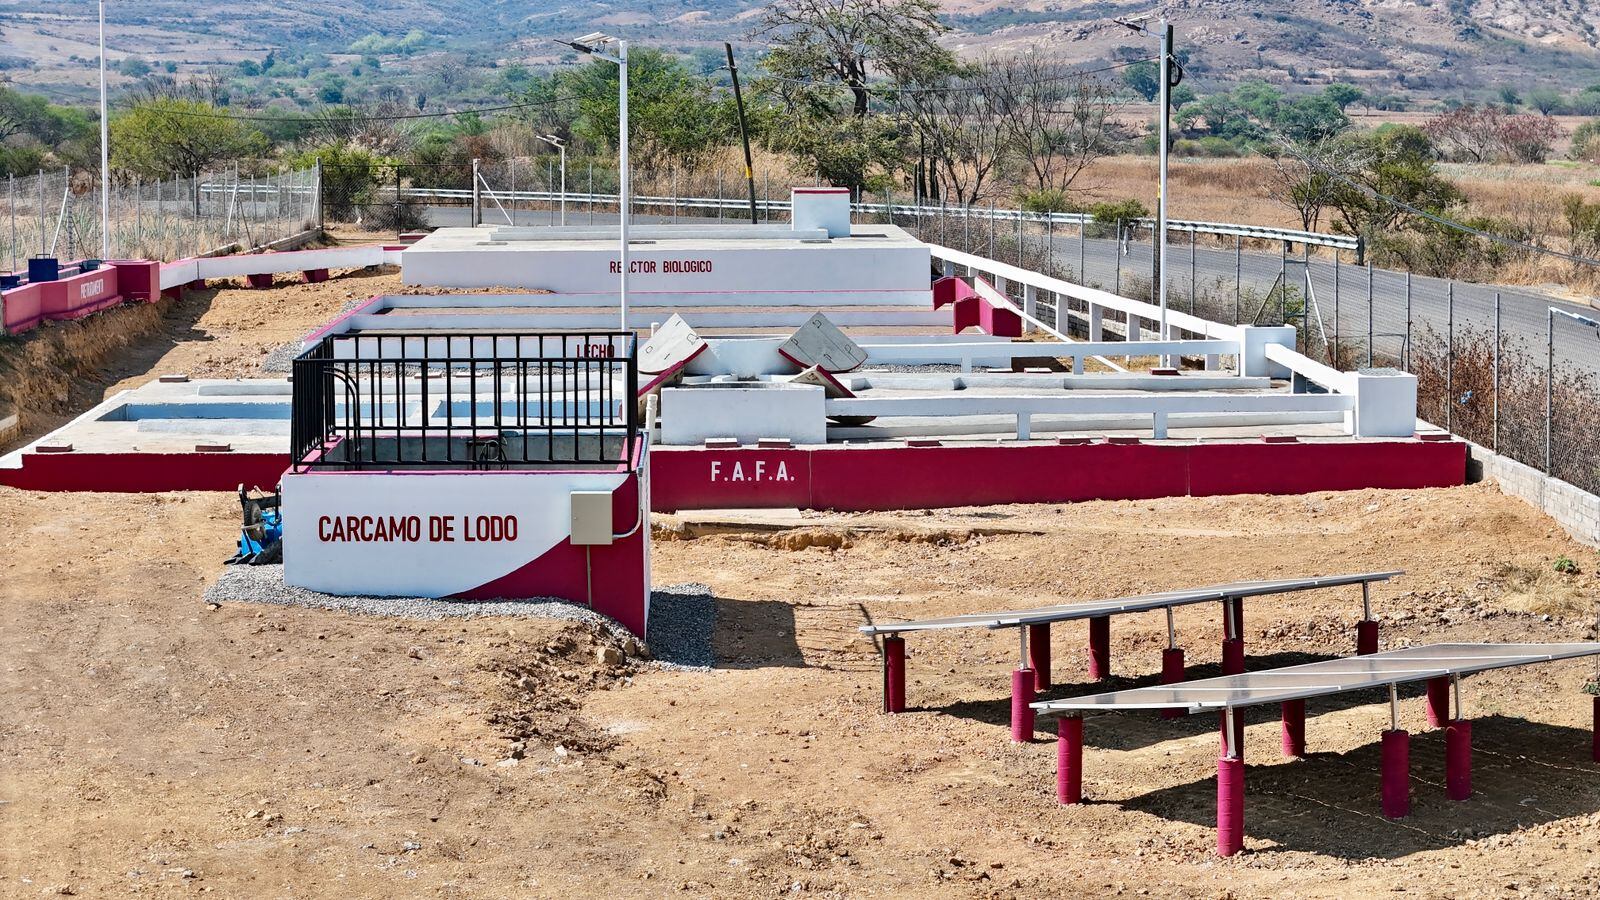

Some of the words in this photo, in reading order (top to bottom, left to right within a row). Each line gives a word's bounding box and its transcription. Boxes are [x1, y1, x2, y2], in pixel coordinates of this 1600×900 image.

[609, 260, 657, 274] RECTOR
[663, 260, 712, 273] BIOLOGICO
[711, 460, 795, 482] F.A.F.A.
[318, 515, 421, 542] CARCAMO
[429, 515, 455, 542] DE
[464, 515, 518, 542] LODO
